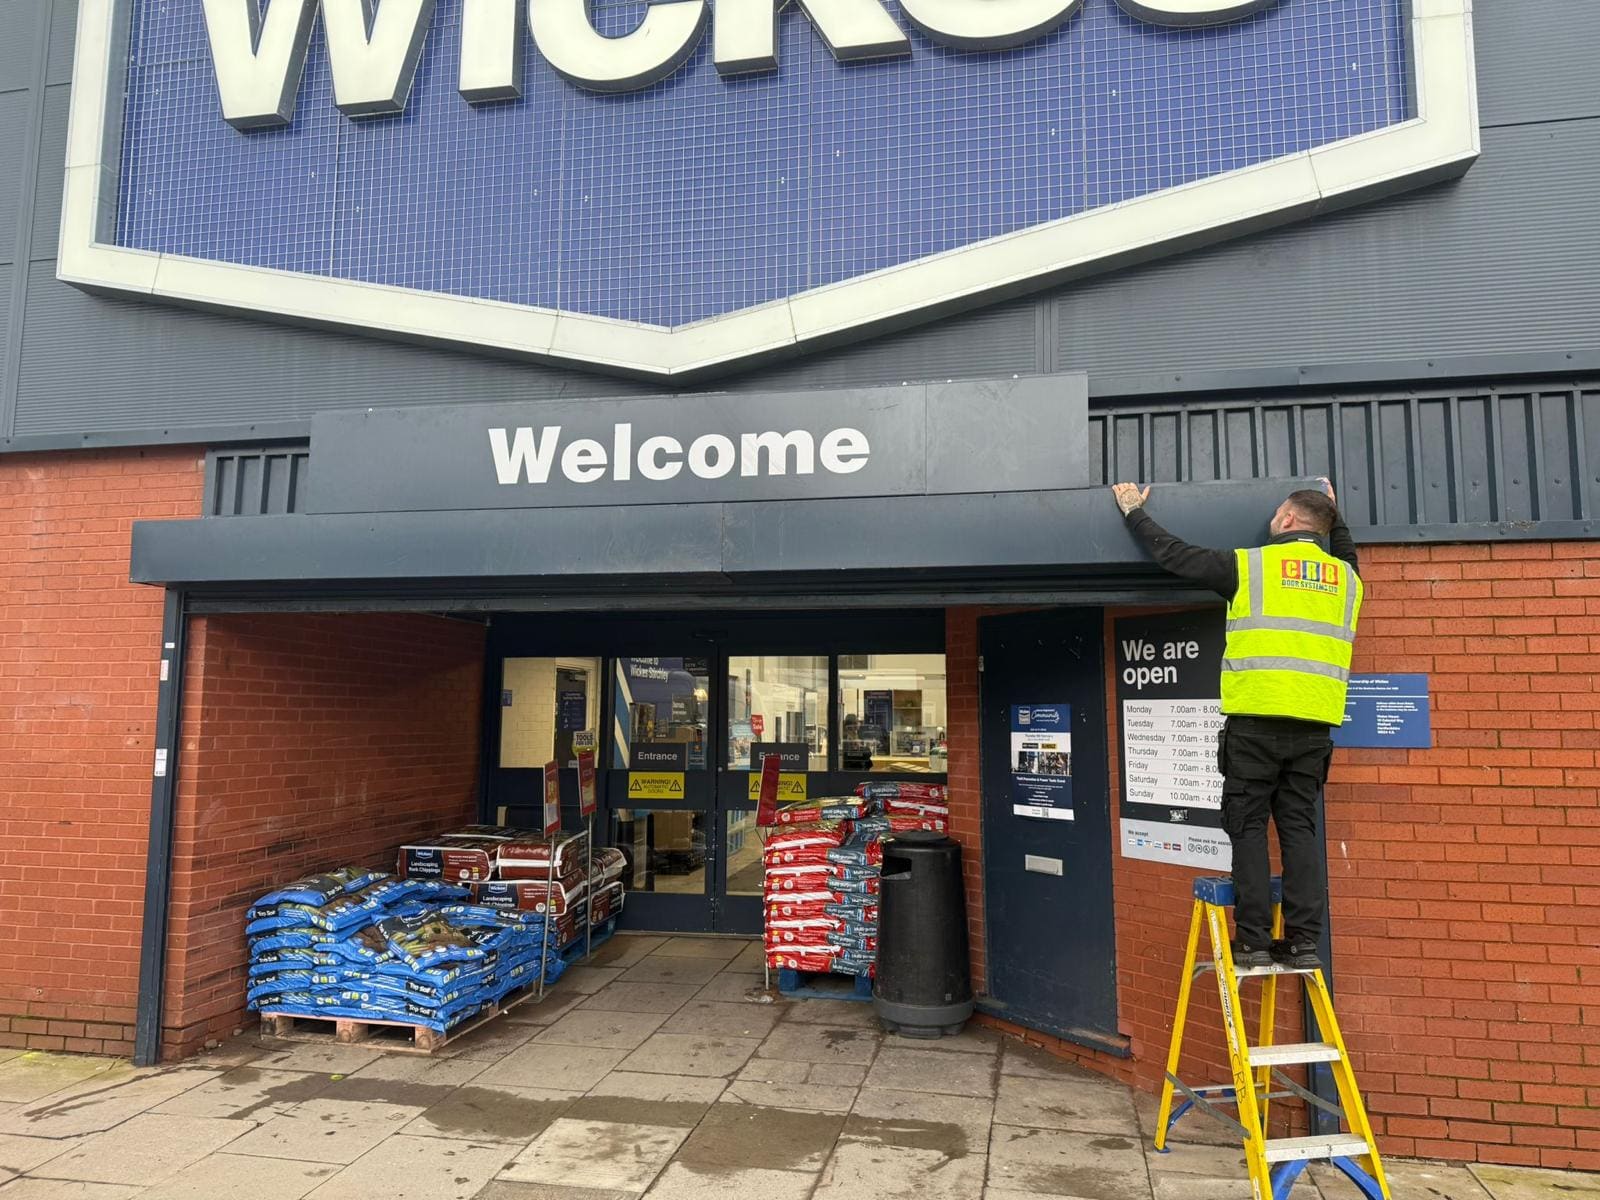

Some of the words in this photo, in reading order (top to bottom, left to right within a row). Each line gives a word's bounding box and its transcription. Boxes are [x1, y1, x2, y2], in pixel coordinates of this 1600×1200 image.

[487, 423, 871, 485] Welcome
[1122, 639, 1156, 662] We
[1162, 640, 1200, 660] are
[1122, 664, 1178, 690] open
[1126, 706, 1152, 714] Monday
[1128, 720, 1153, 729] Tuesday
[1171, 720, 1197, 728] 7.00am
[1128, 734, 1165, 743] Wednesday
[638, 752, 678, 760] Entrance
[1128, 746, 1158, 757] Thursday
[1172, 749, 1198, 757] 7.00am
[1129, 760, 1148, 770] Friday
[1172, 764, 1199, 772] 7.00am
[1129, 775, 1158, 785] Saturday
[1173, 778, 1200, 786] 7.00am
[1129, 788, 1154, 799] Sunday
[1170, 792, 1200, 800] 10.00am
[409, 982, 419, 990] Top
[419, 985, 430, 994] Soil
[409, 1004, 419, 1012] Top
[420, 1007, 430, 1015] Soil
[1232, 1053, 1246, 1104] CRB
